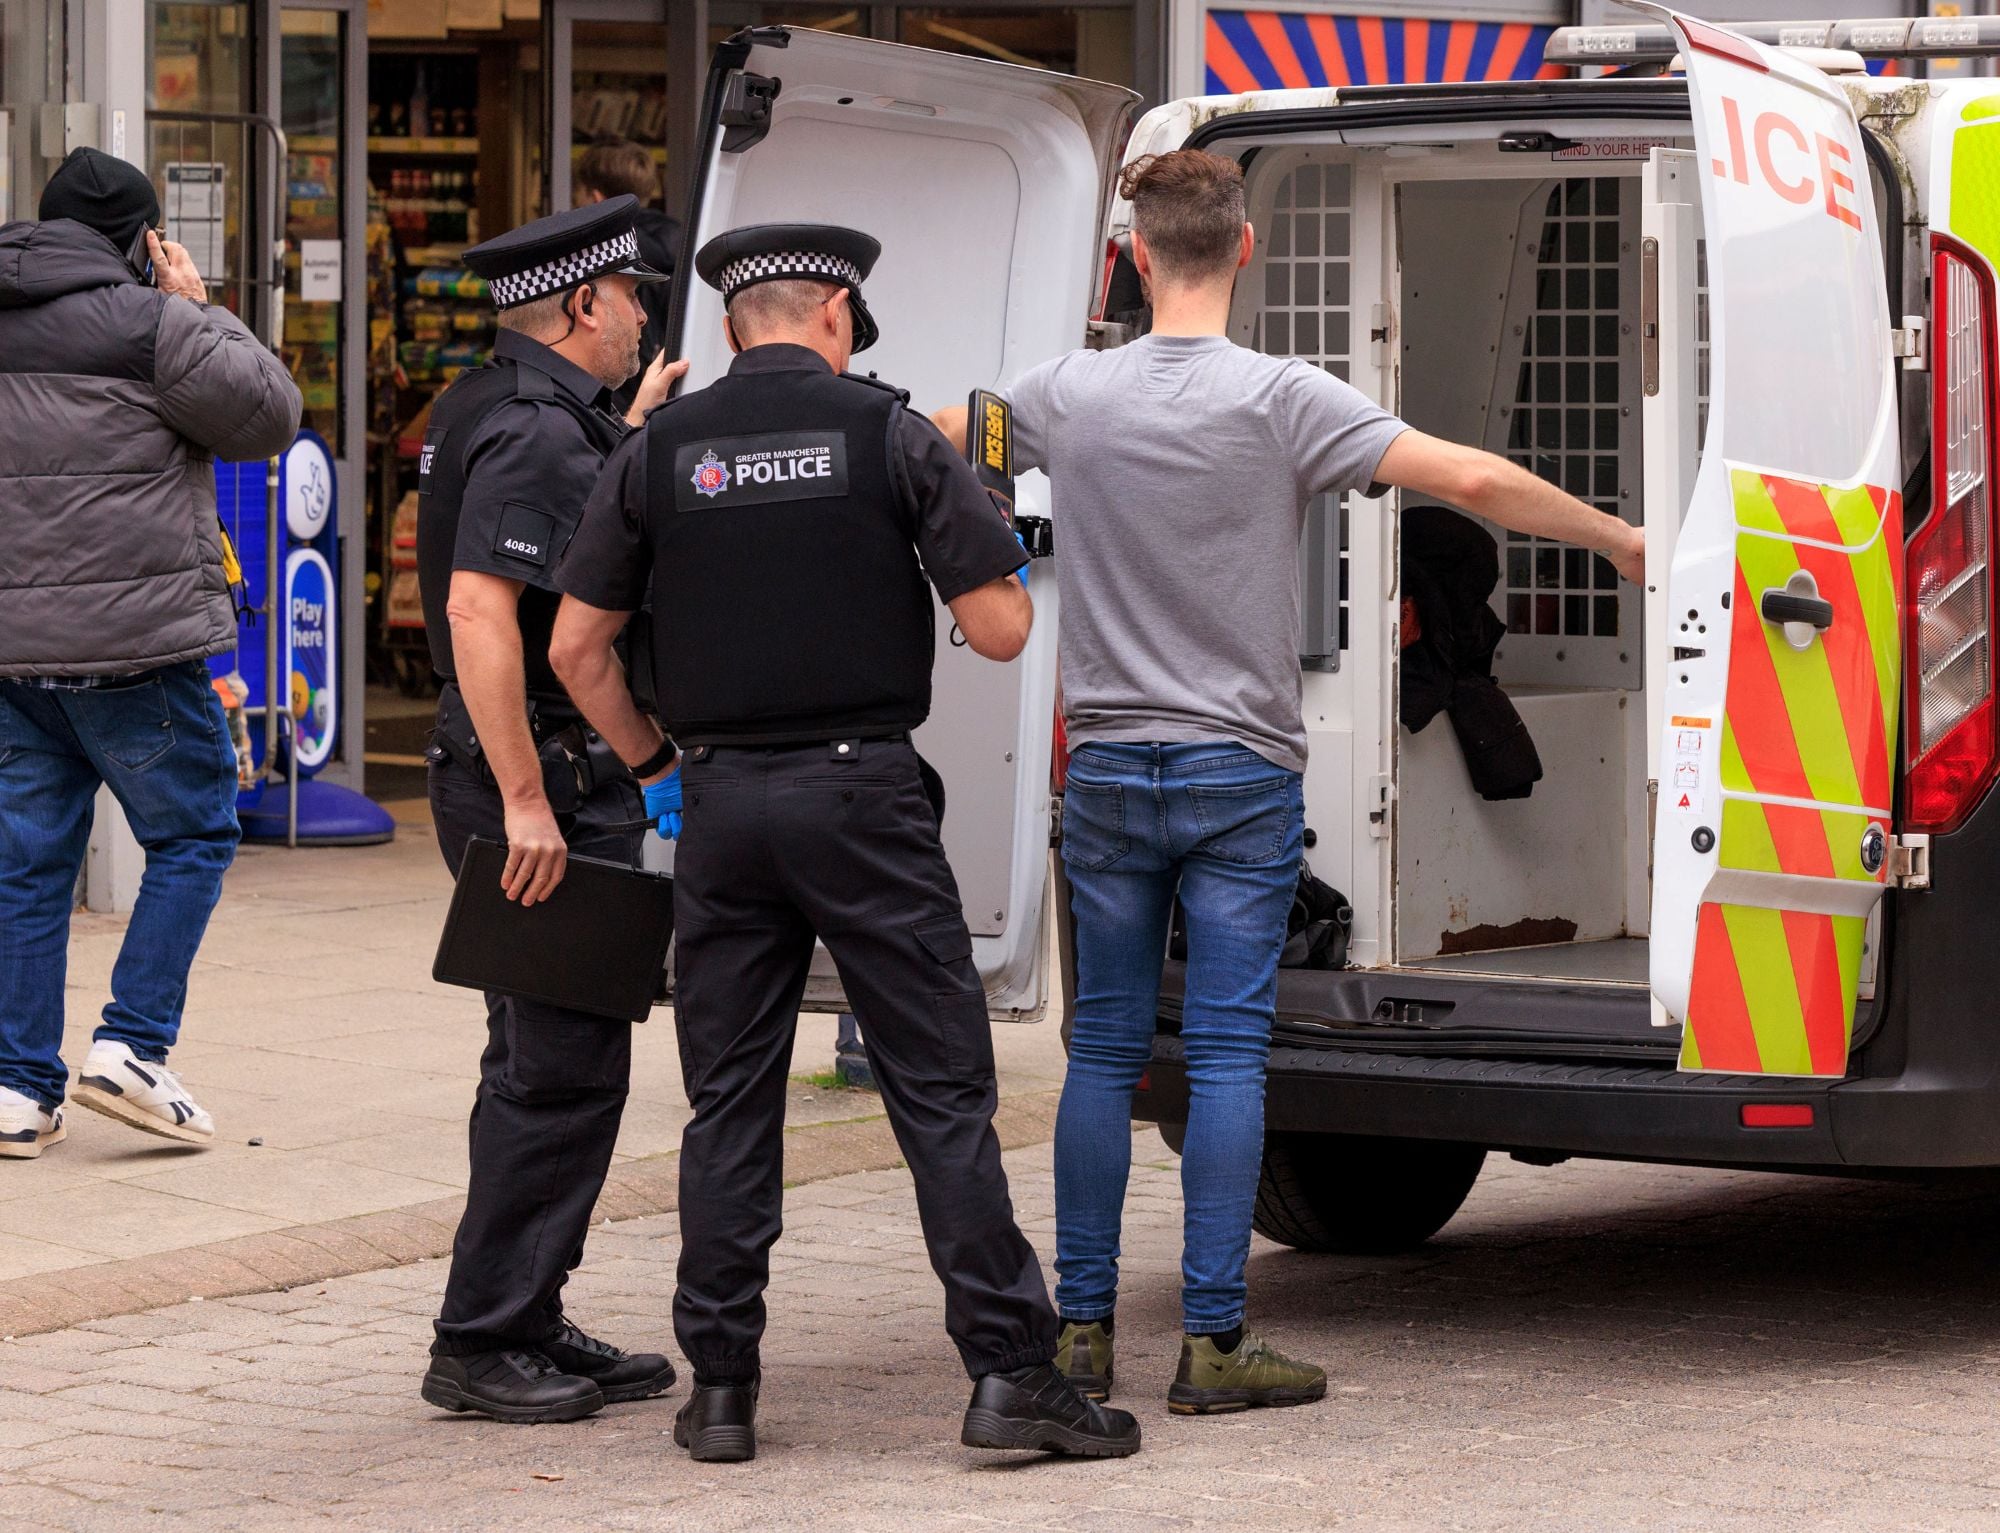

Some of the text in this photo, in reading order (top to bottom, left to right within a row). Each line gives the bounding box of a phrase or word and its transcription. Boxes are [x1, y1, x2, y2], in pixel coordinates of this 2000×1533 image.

[1593, 143, 1629, 156] YOUR
[1712, 96, 1862, 232] ICE
[735, 446, 830, 464] GREATER MANCHESTER
[735, 455, 832, 486] POLICE
[504, 538, 538, 555] 40829
[292, 597, 323, 628] Play
[292, 625, 323, 648] here
